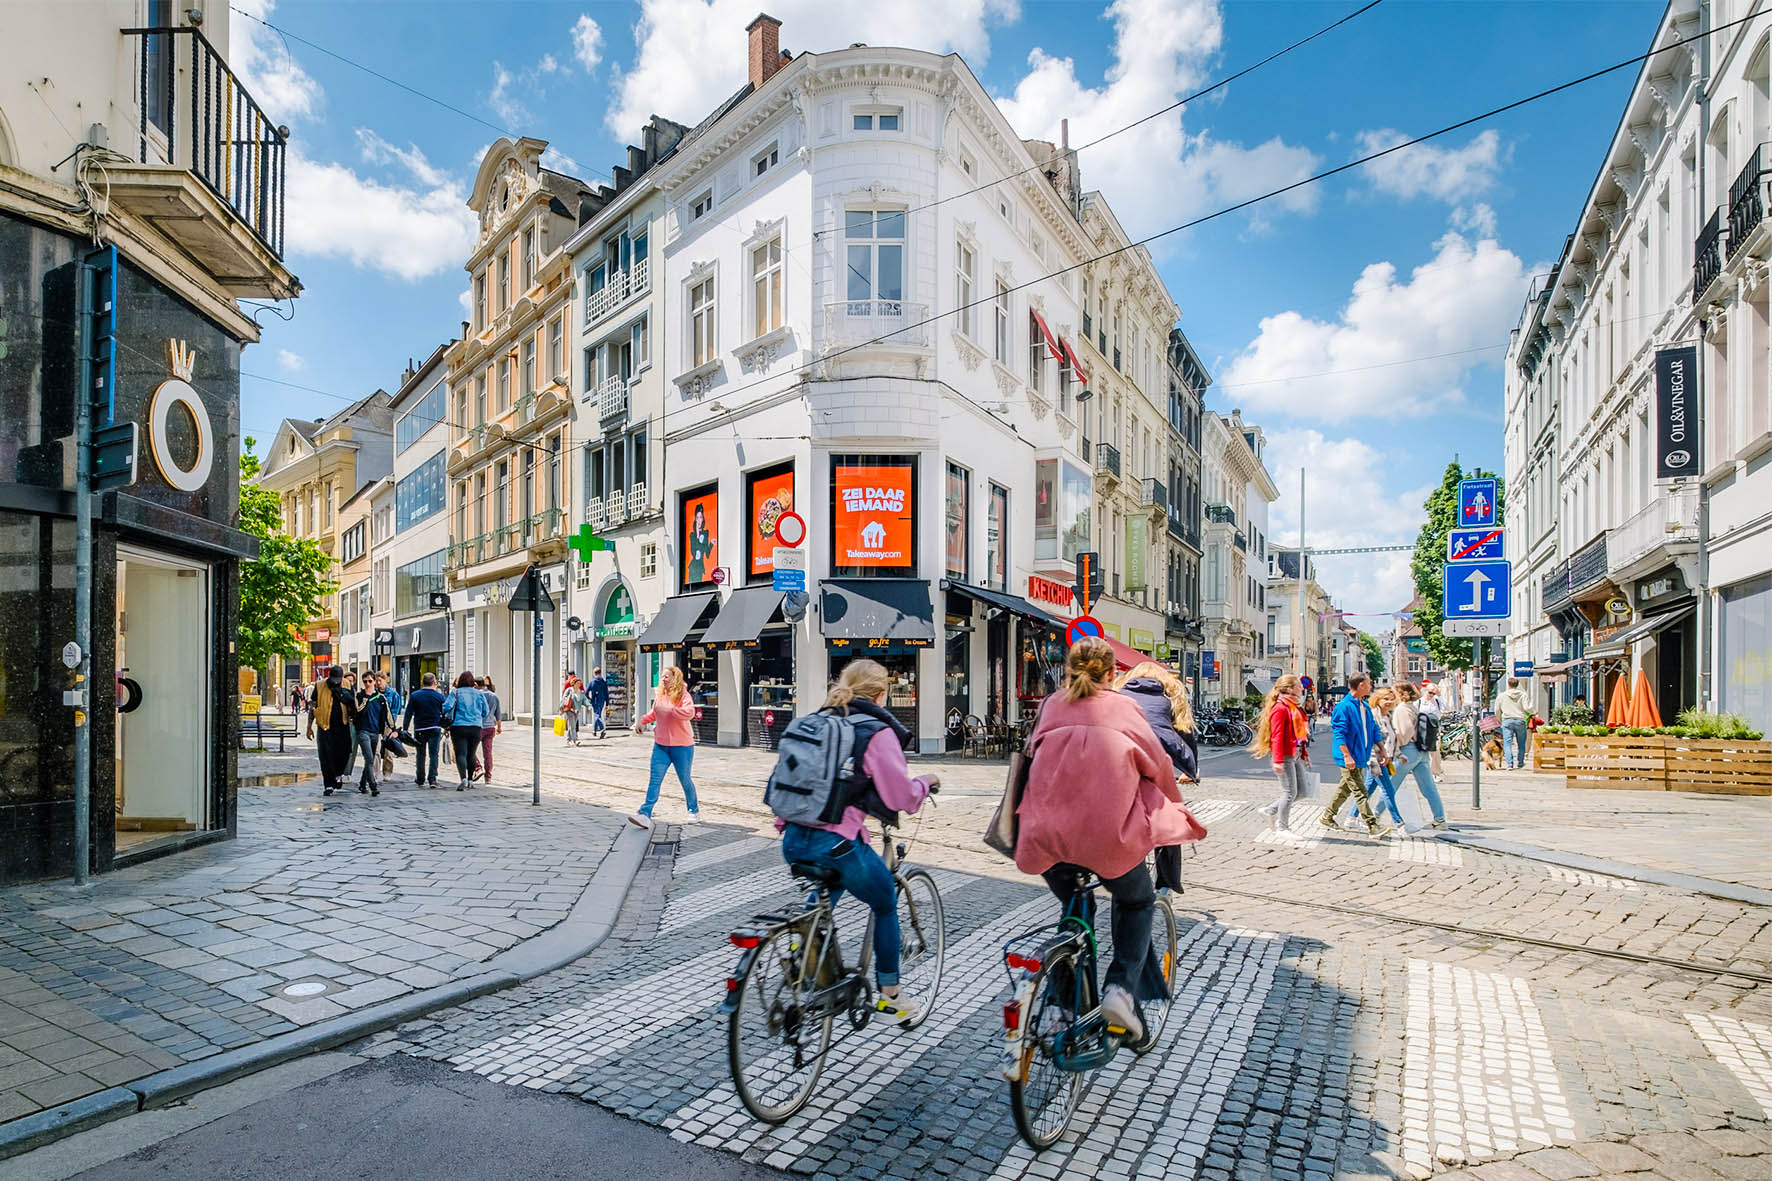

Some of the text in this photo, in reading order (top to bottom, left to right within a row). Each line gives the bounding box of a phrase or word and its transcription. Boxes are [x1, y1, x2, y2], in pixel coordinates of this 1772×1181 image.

[1670, 359, 1685, 443] OIL&VINEGAR
[841, 487, 905, 501] ZEI DAAR
[845, 499, 904, 512] IEMAND
[846, 549, 902, 560] Takeaway.com
[1032, 577, 1074, 607] KETCHUP
